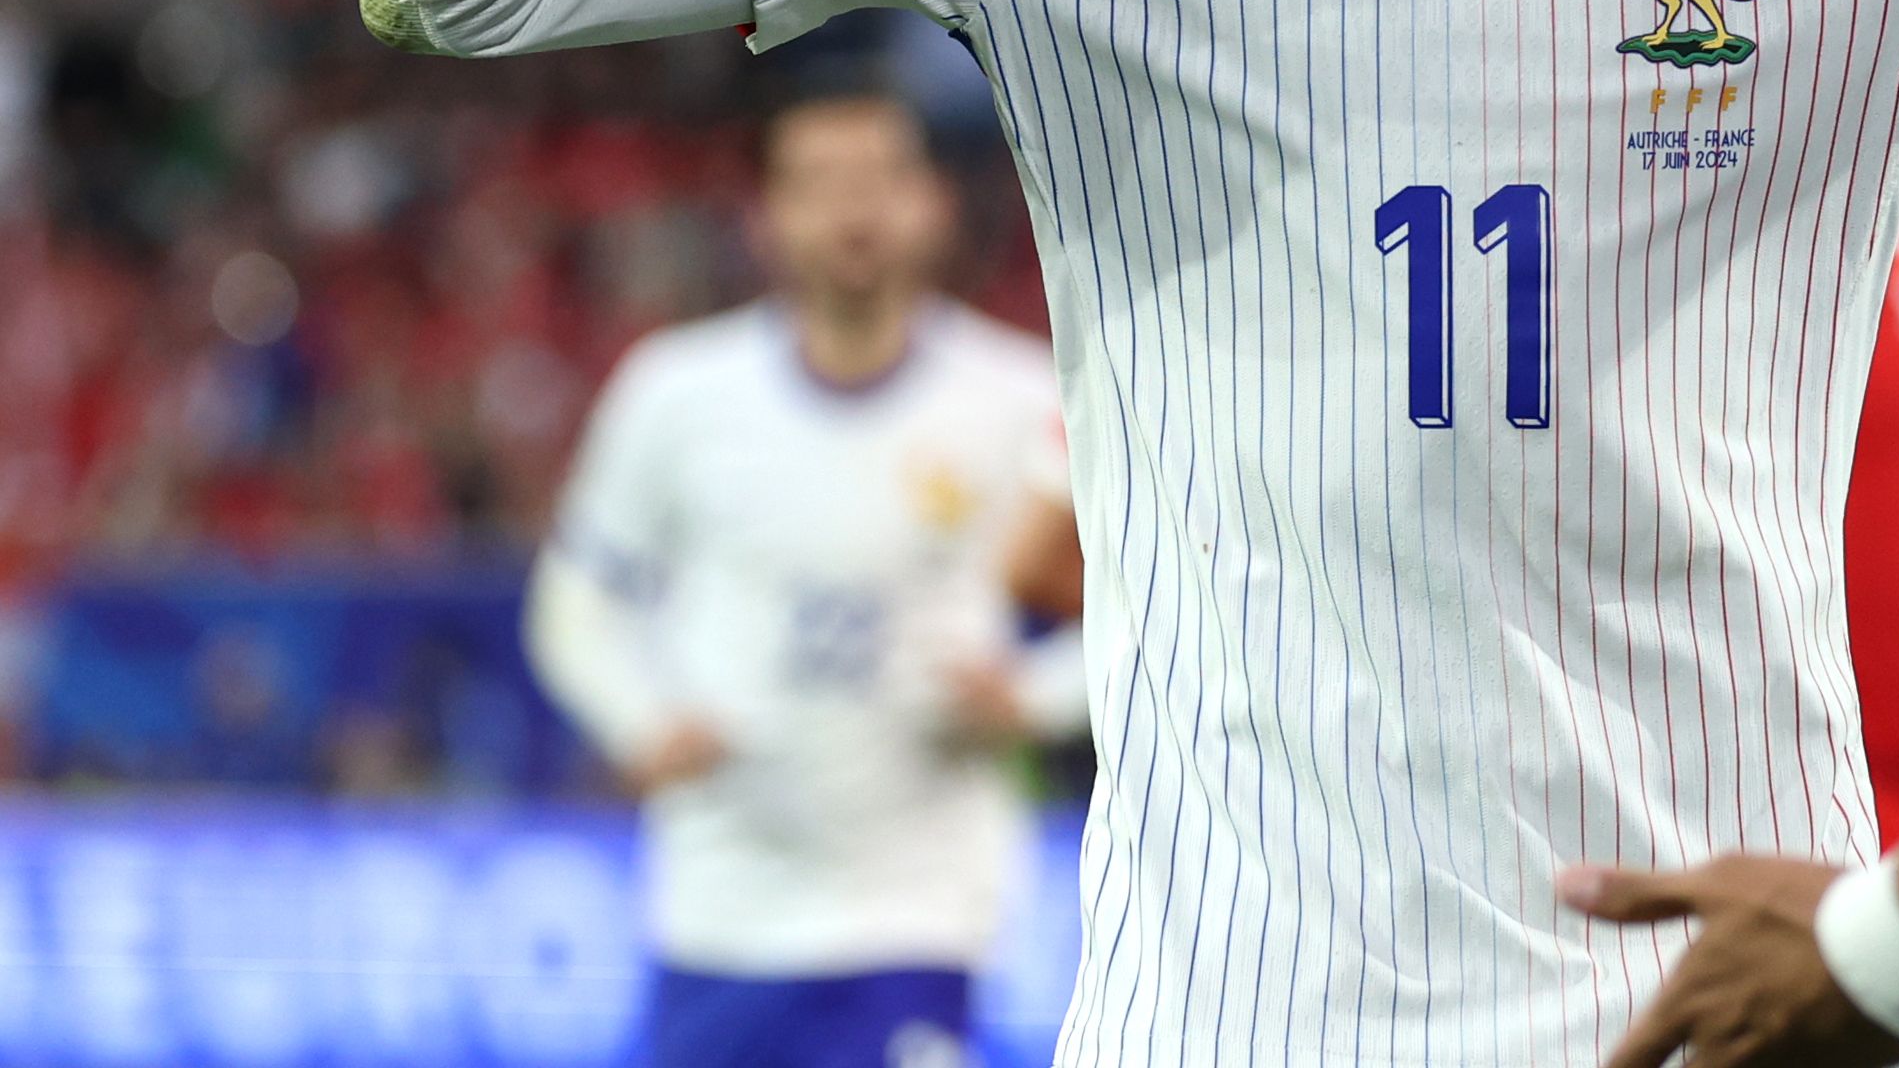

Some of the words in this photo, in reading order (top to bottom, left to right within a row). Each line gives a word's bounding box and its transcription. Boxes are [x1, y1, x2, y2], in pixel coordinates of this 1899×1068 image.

[1627, 131, 1688, 150] AUTRICHE
[1704, 129, 1756, 148] FRANCE
[1642, 151, 1656, 170] 17
[1662, 152, 1690, 170] JUIN
[1695, 150, 1738, 169] 2024
[1374, 184, 1550, 429] 11
